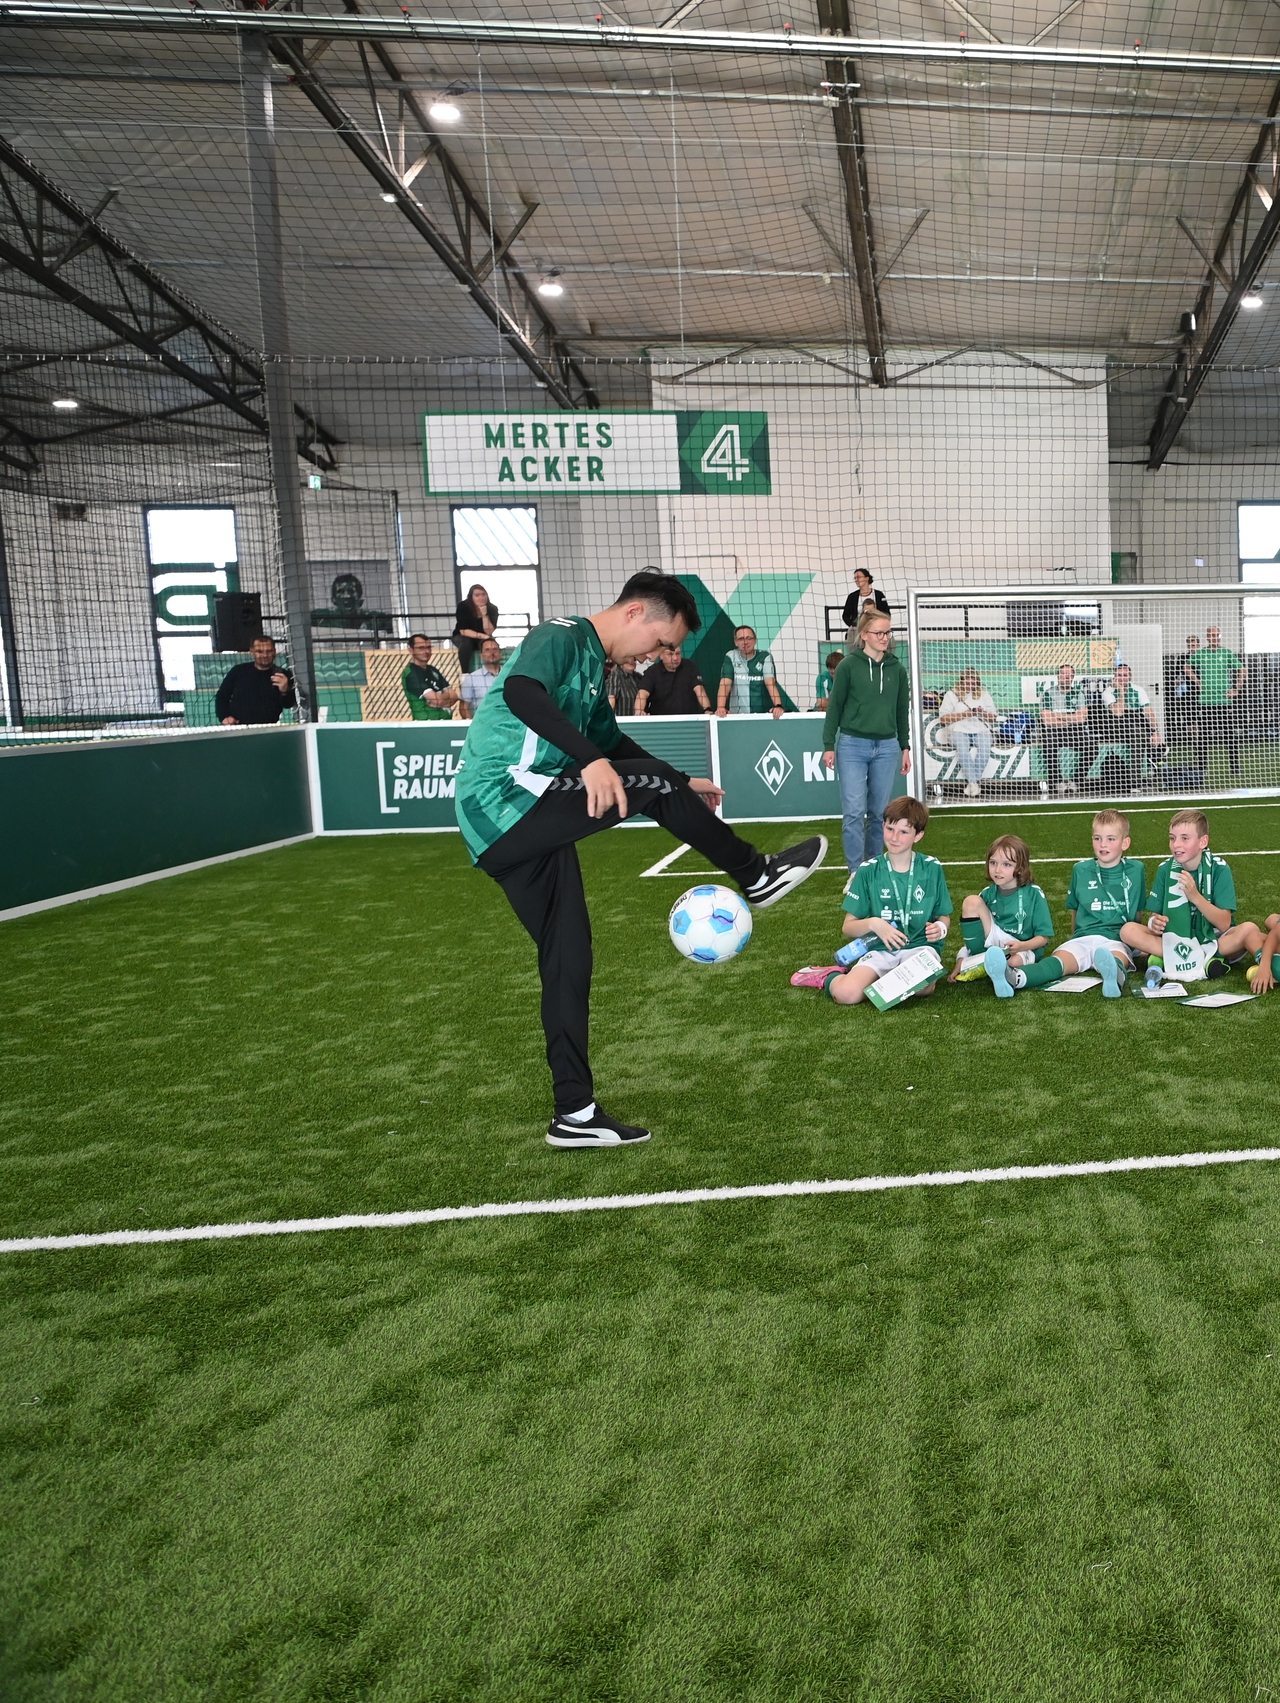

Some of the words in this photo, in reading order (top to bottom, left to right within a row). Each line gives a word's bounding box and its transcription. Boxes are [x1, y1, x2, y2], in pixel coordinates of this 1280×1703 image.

[484, 422, 613, 449] MERTES
[701, 424, 750, 482] 4
[498, 455, 606, 483] ACKER
[393, 753, 460, 777] SPIEL
[393, 777, 456, 800] RAUM
[1175, 961, 1197, 972] KIDS
